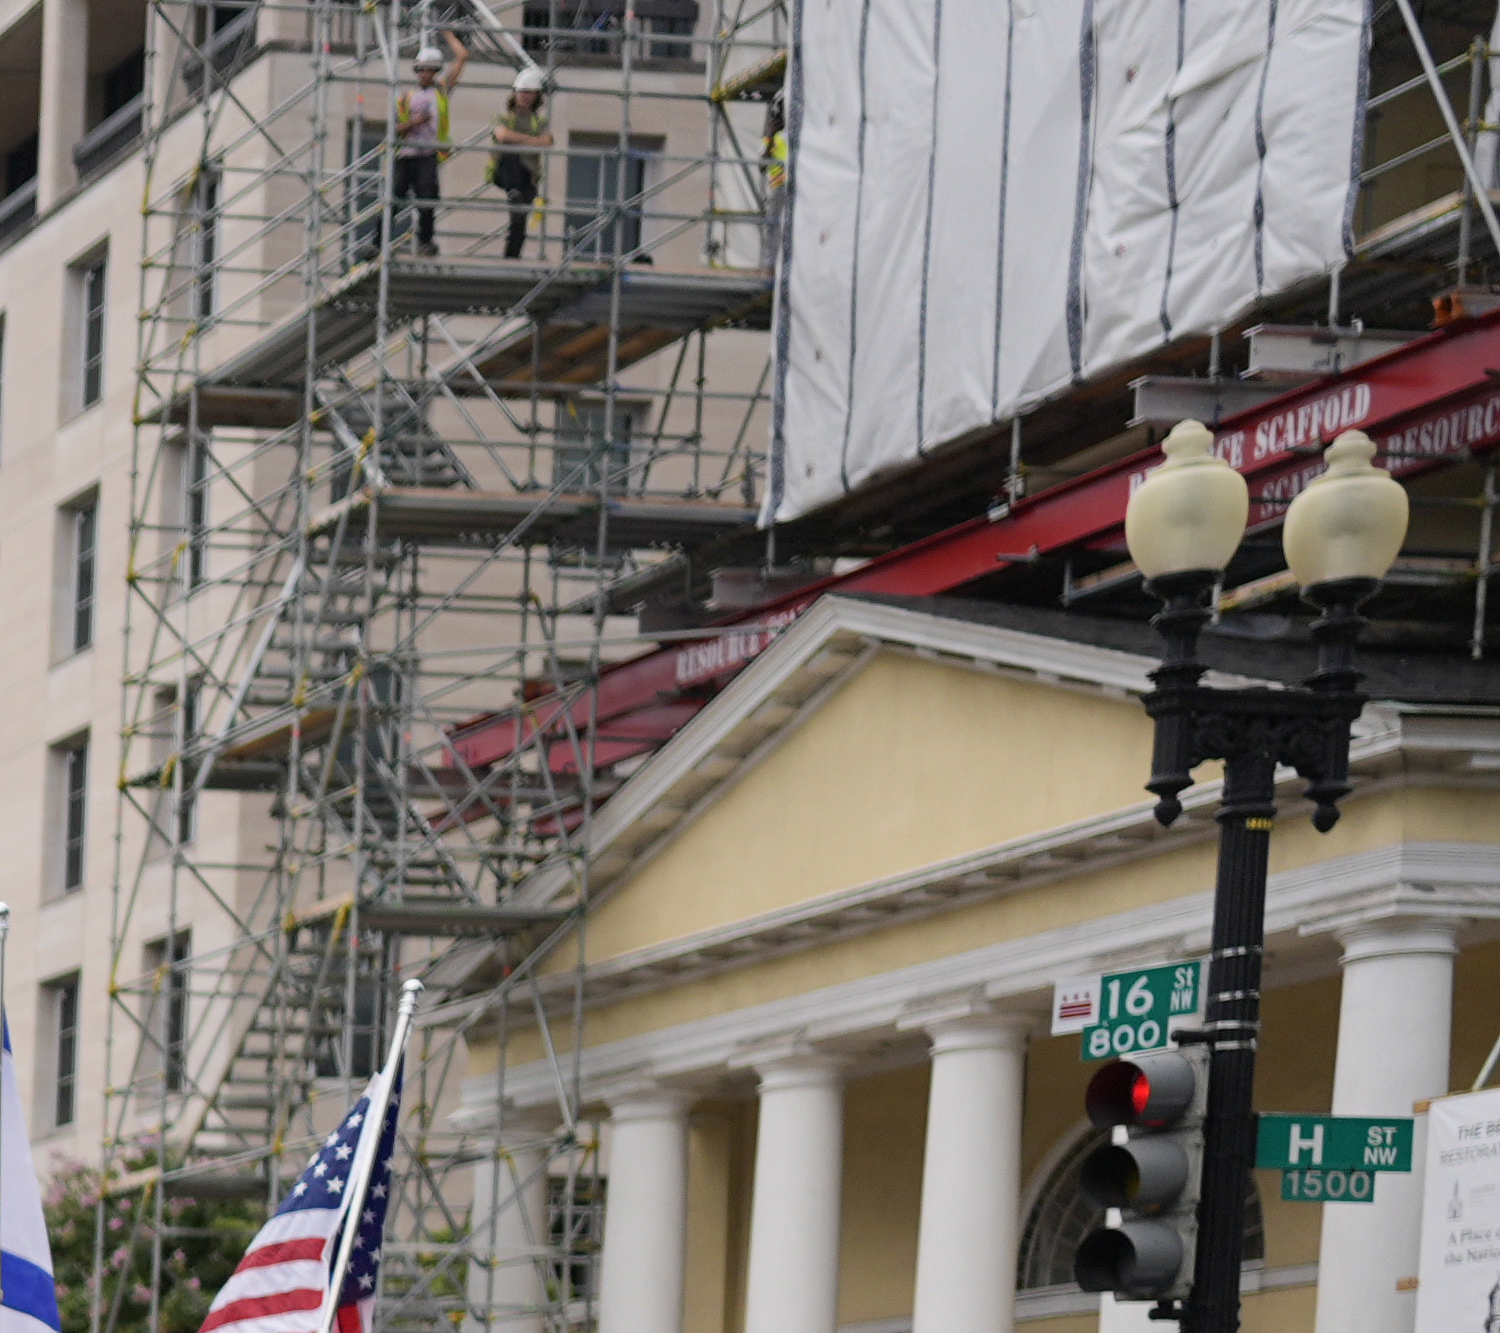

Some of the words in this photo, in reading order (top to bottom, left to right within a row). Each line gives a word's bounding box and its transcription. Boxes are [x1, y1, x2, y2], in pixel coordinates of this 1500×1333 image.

[1254, 383, 1371, 460] SCAFFOLD
[1108, 975, 1154, 1019] 16
[1174, 966, 1194, 989] St
[1170, 987, 1193, 1012] NW
[1090, 1020, 1160, 1057] 800
[1289, 1124, 1324, 1165] H
[1367, 1125, 1397, 1146] ST
[1364, 1146, 1397, 1166] NW
[1286, 1170, 1370, 1199] 1500
